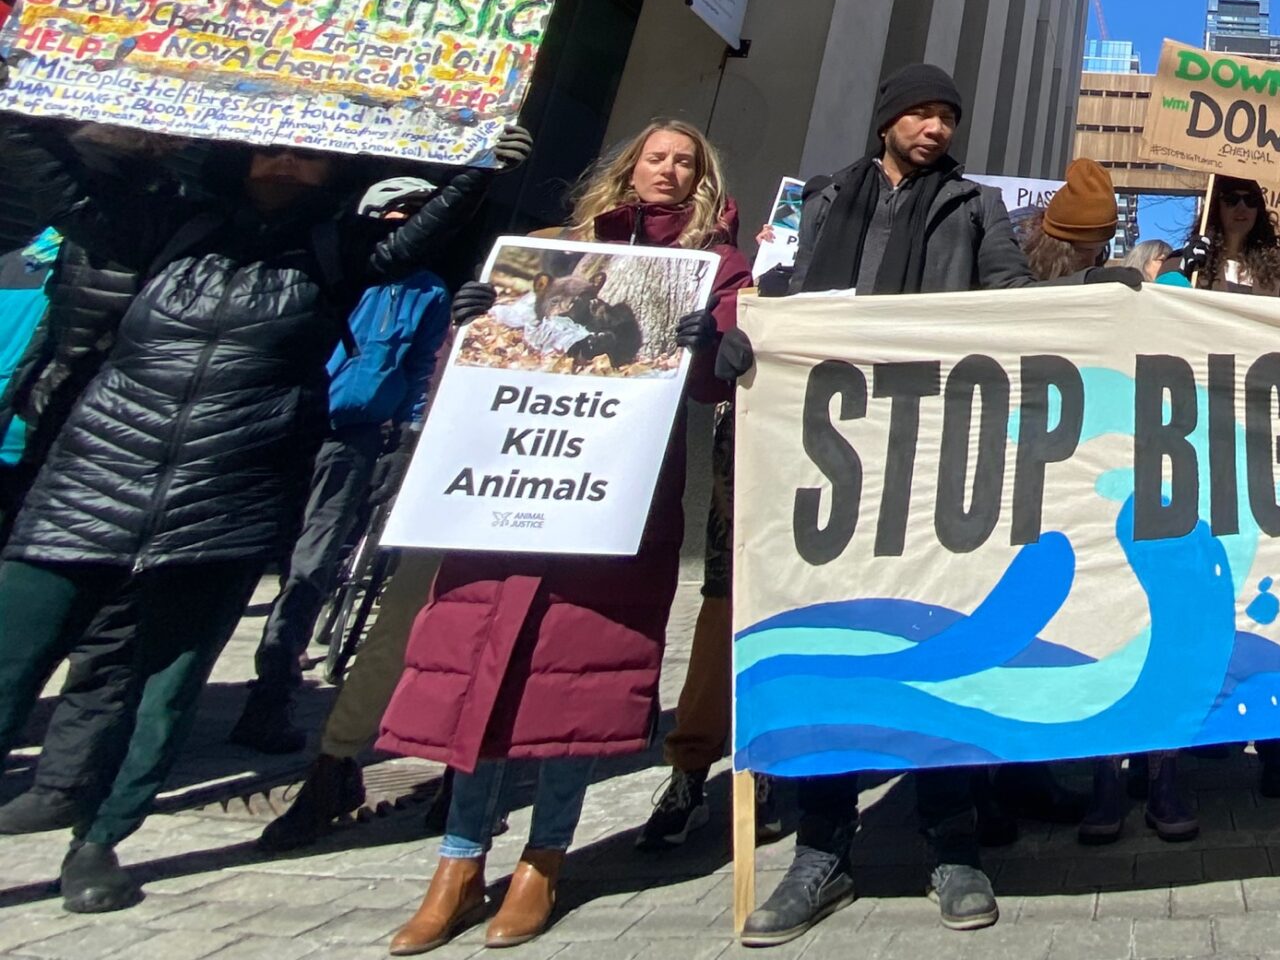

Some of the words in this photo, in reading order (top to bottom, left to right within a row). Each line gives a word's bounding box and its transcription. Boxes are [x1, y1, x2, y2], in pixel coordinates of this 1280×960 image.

[150, 1, 284, 48] Chemical
[316, 32, 442, 65] Imperial
[18, 27, 103, 59] HELP
[257, 48, 417, 91] Chemicals
[431, 85, 498, 113] HELP
[301, 101, 364, 123] found
[1162, 96, 1190, 113] WITH
[490, 384, 621, 419] Plastic
[500, 427, 585, 459] Kills
[793, 353, 1085, 566] STOP
[443, 467, 609, 502] Animals
[509, 520, 545, 528] JUSTICE
[513, 512, 545, 520] ANIMAL
